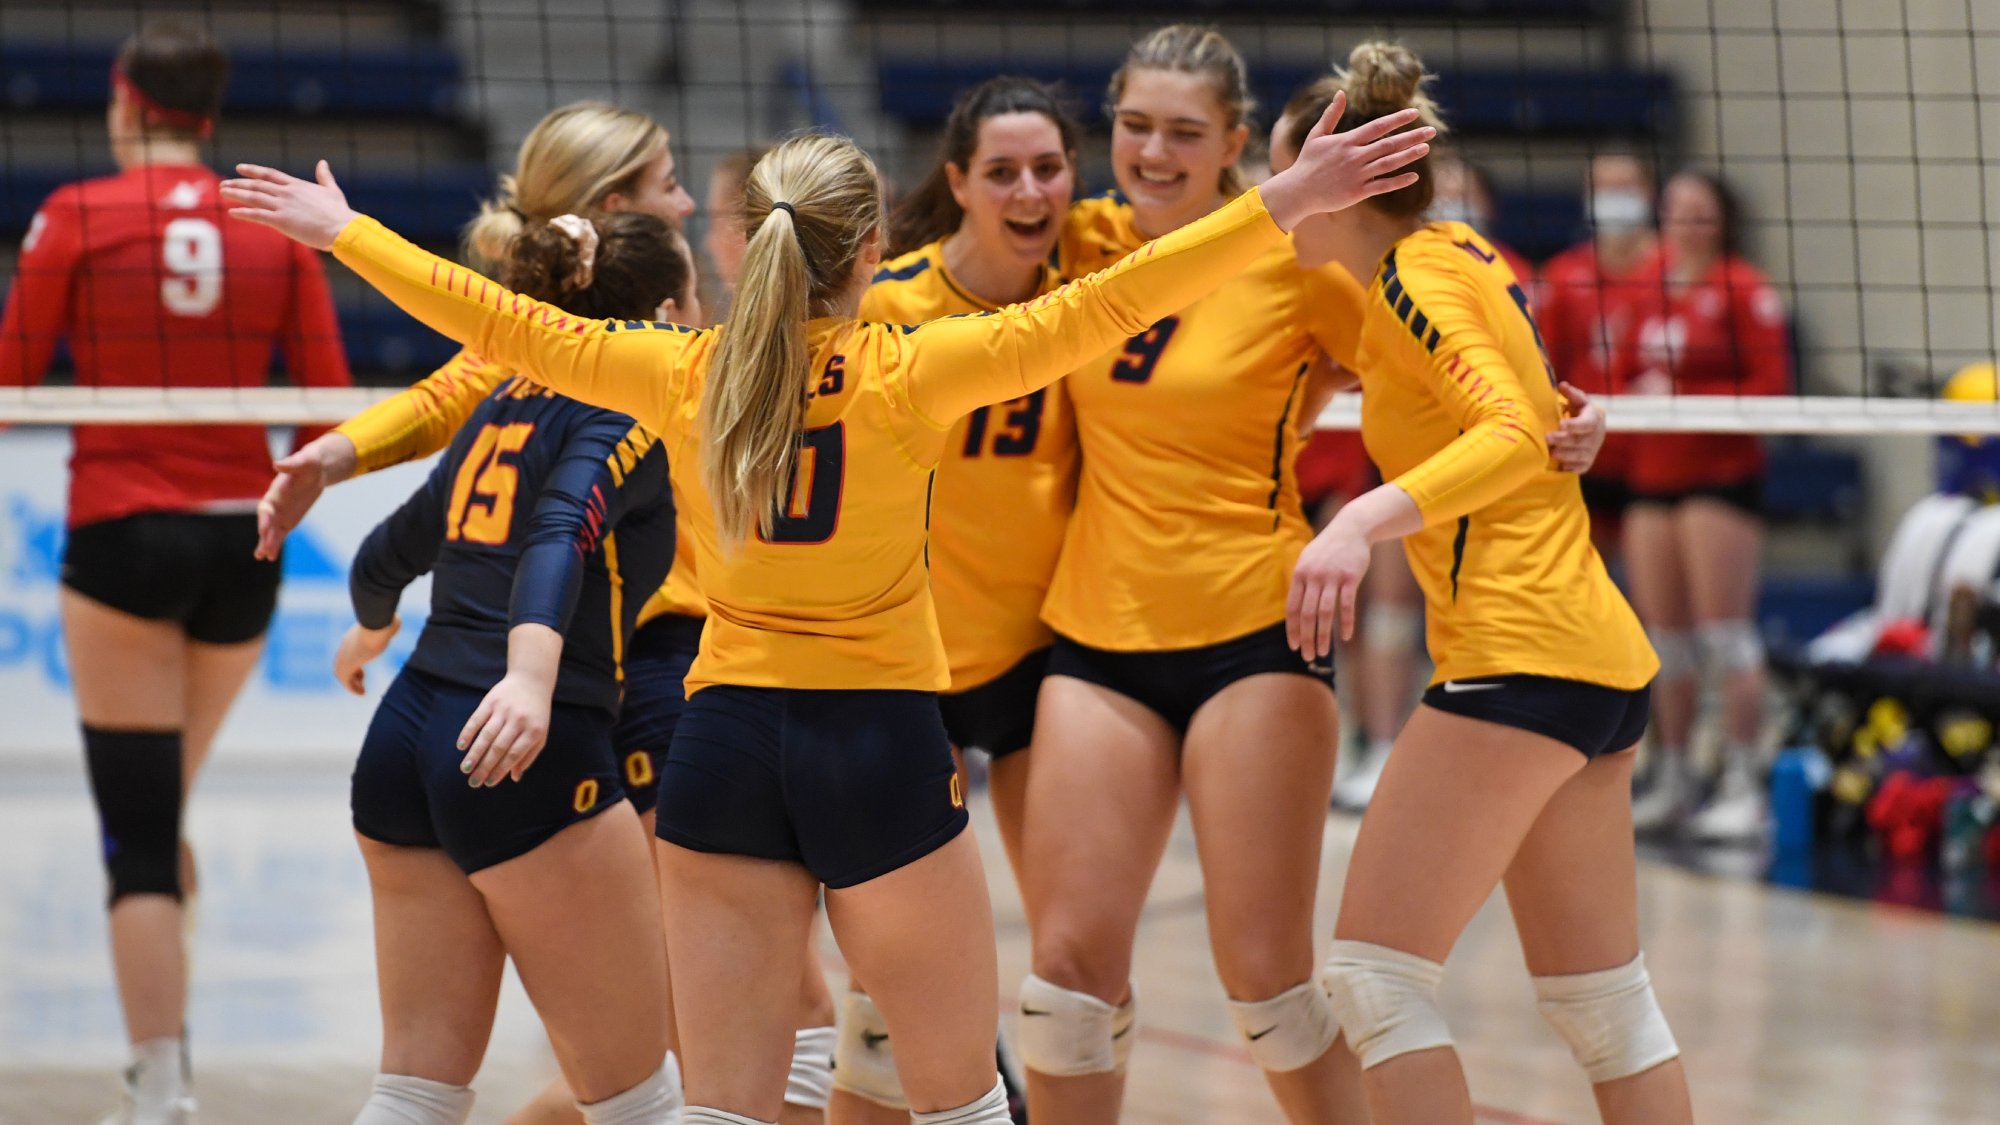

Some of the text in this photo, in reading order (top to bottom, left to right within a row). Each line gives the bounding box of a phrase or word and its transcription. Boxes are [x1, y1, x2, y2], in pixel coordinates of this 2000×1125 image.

[160, 217, 223, 317] 9
[1109, 315, 1180, 384] 9
[961, 386, 1048, 458] 13
[446, 421, 536, 545] 15
